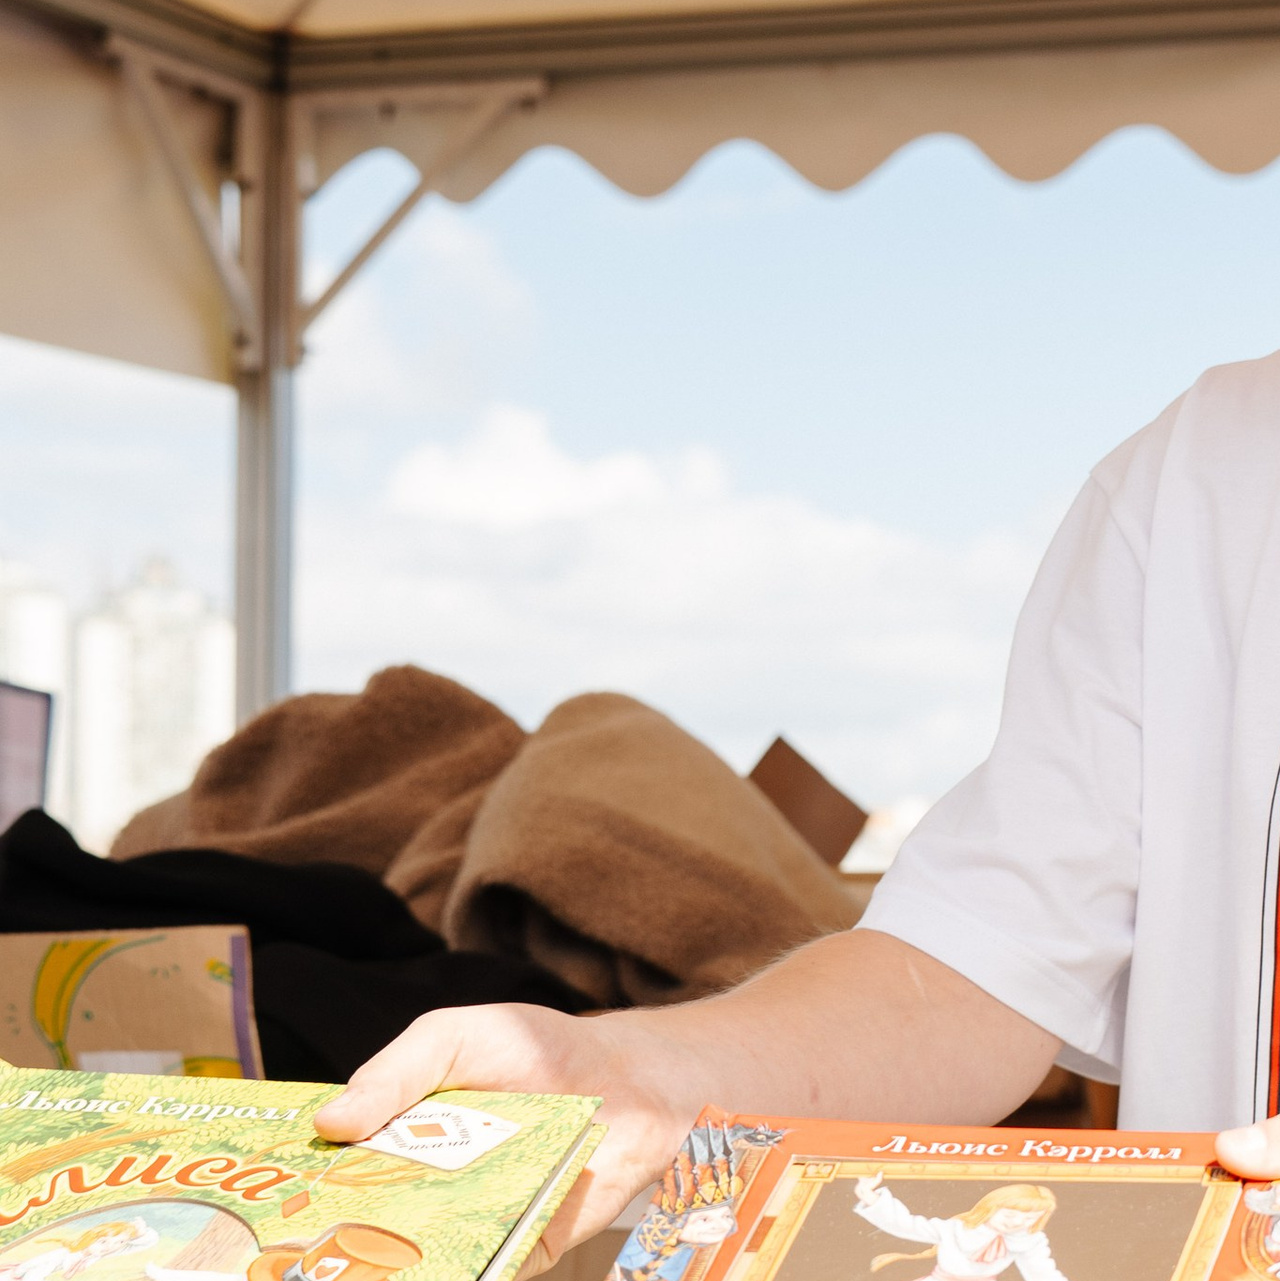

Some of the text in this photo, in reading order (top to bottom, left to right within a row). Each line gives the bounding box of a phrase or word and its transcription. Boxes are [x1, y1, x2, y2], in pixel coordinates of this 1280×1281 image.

[2, 1090, 301, 1121] Льюис Кэрролл
[872, 1135, 1183, 1163] Льюис Кэрролл
[0, 1154, 298, 1227] лиса
